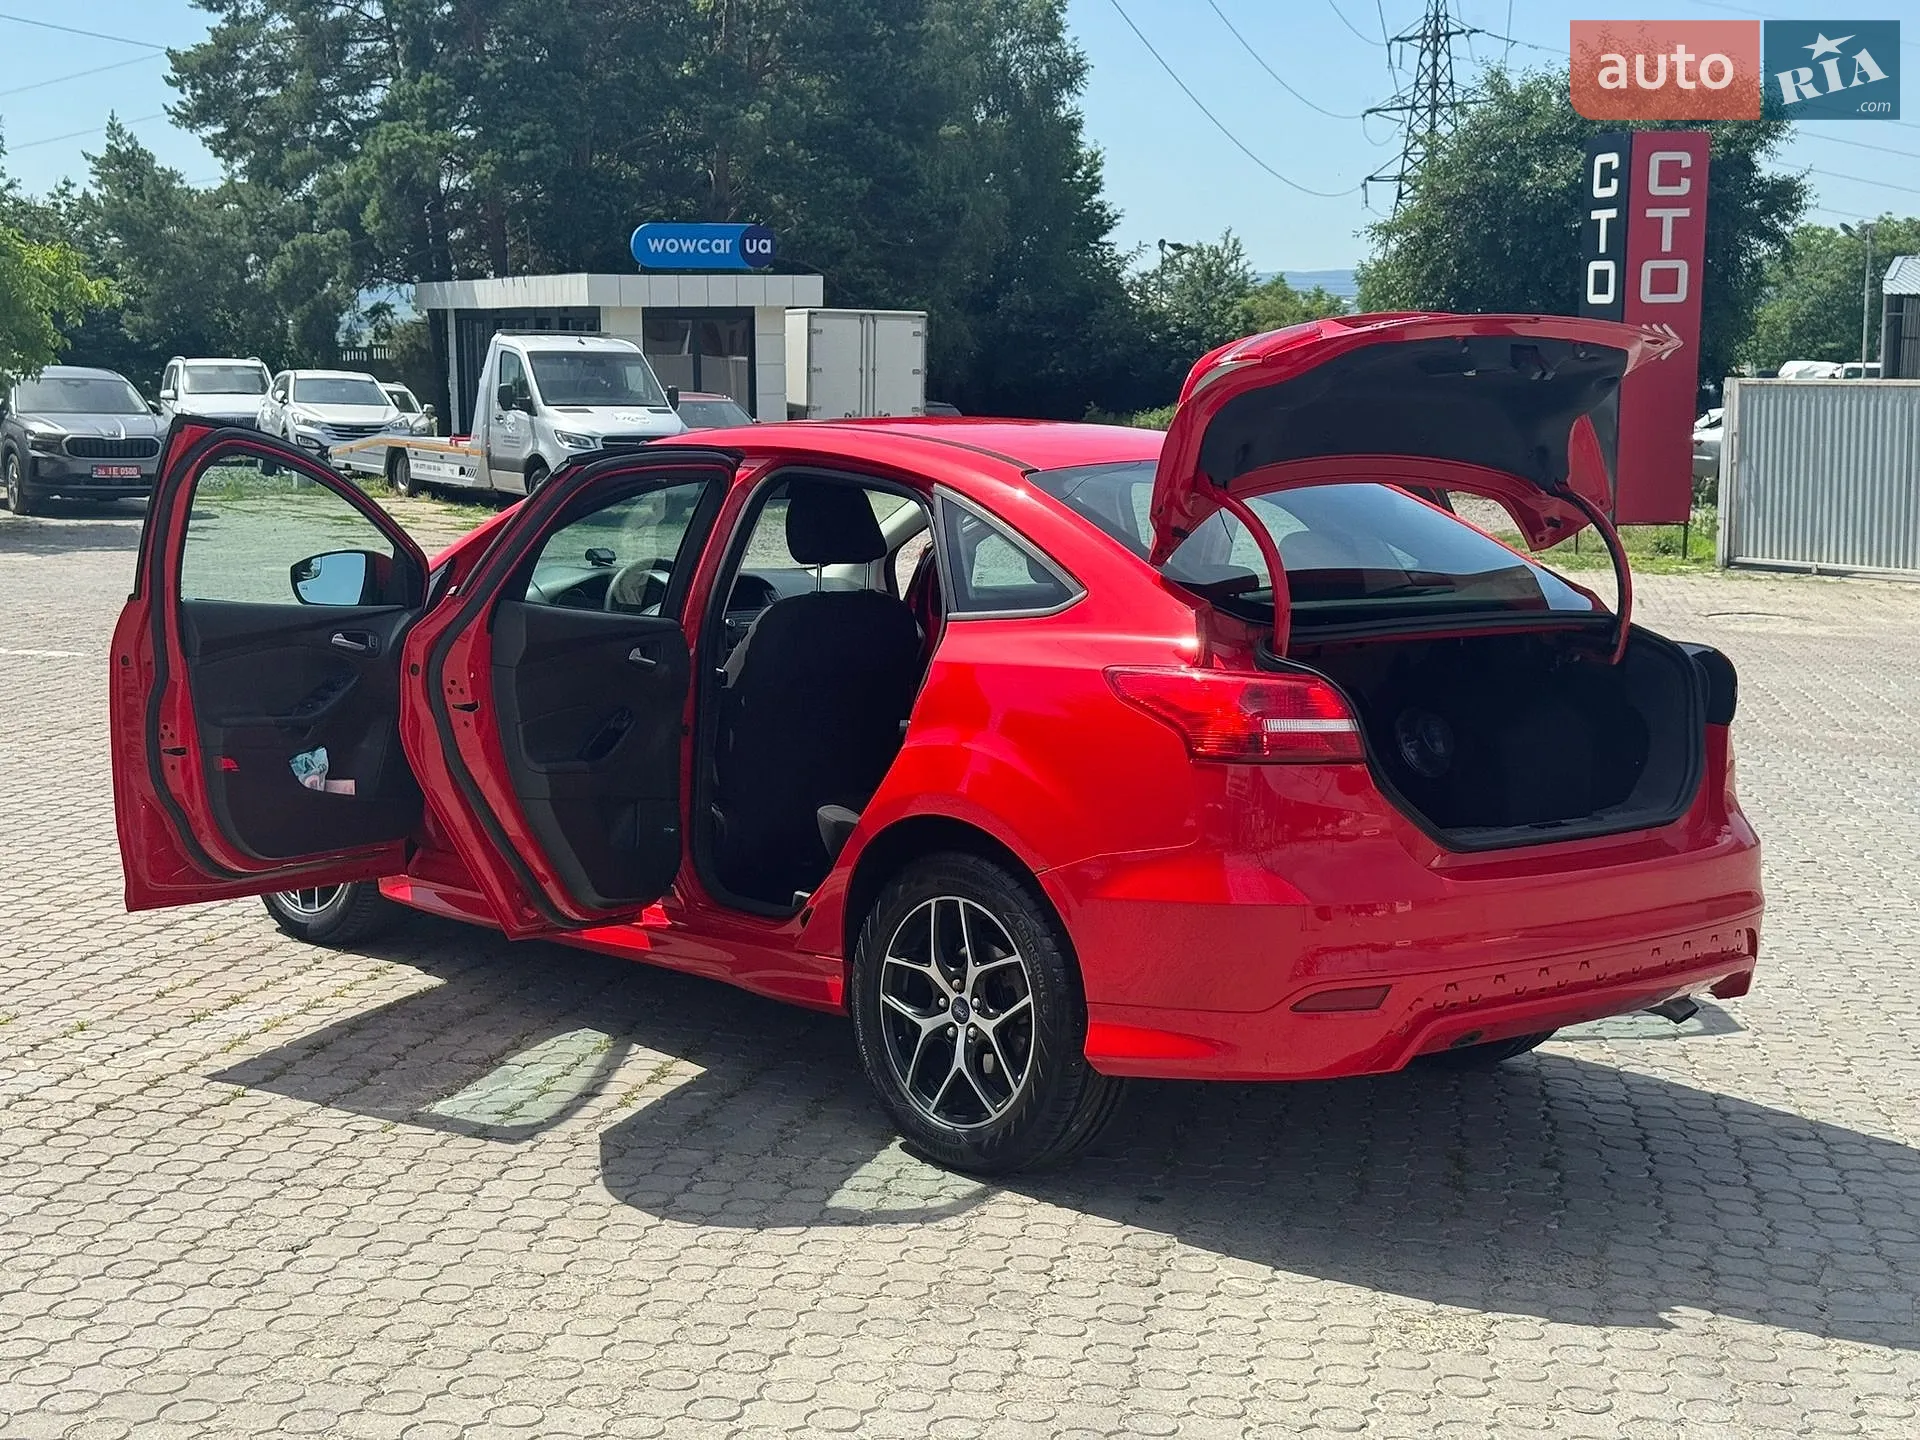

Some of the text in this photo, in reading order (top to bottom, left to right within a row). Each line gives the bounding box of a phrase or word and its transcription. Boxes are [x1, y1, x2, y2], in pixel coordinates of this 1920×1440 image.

[647, 238, 772, 254] wowcar ua
[1587, 152, 1619, 304] СТО
[1640, 151, 1692, 304] СТО
